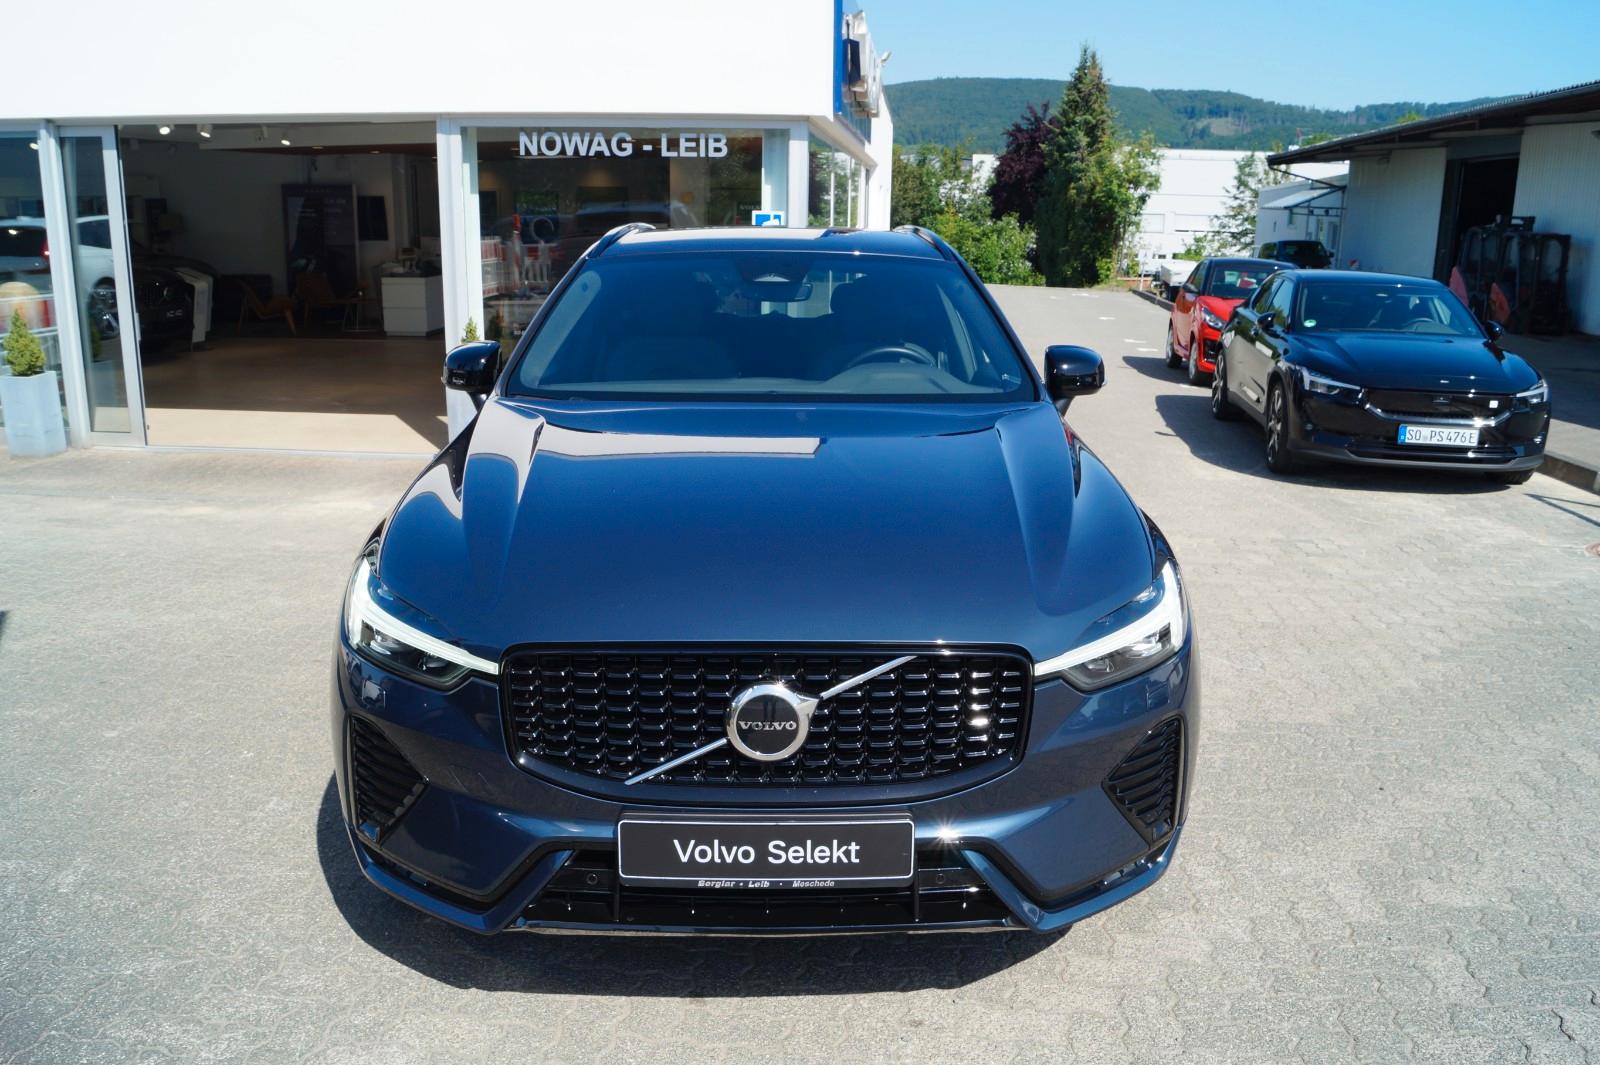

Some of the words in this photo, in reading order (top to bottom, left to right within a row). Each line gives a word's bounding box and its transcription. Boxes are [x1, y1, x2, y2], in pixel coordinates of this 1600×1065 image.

[518, 131, 633, 157] NOWAG
[660, 133, 728, 158] LEIB
[738, 721, 797, 731] VOLVO
[673, 839, 755, 864] Volvo
[767, 839, 860, 864] Selekt
